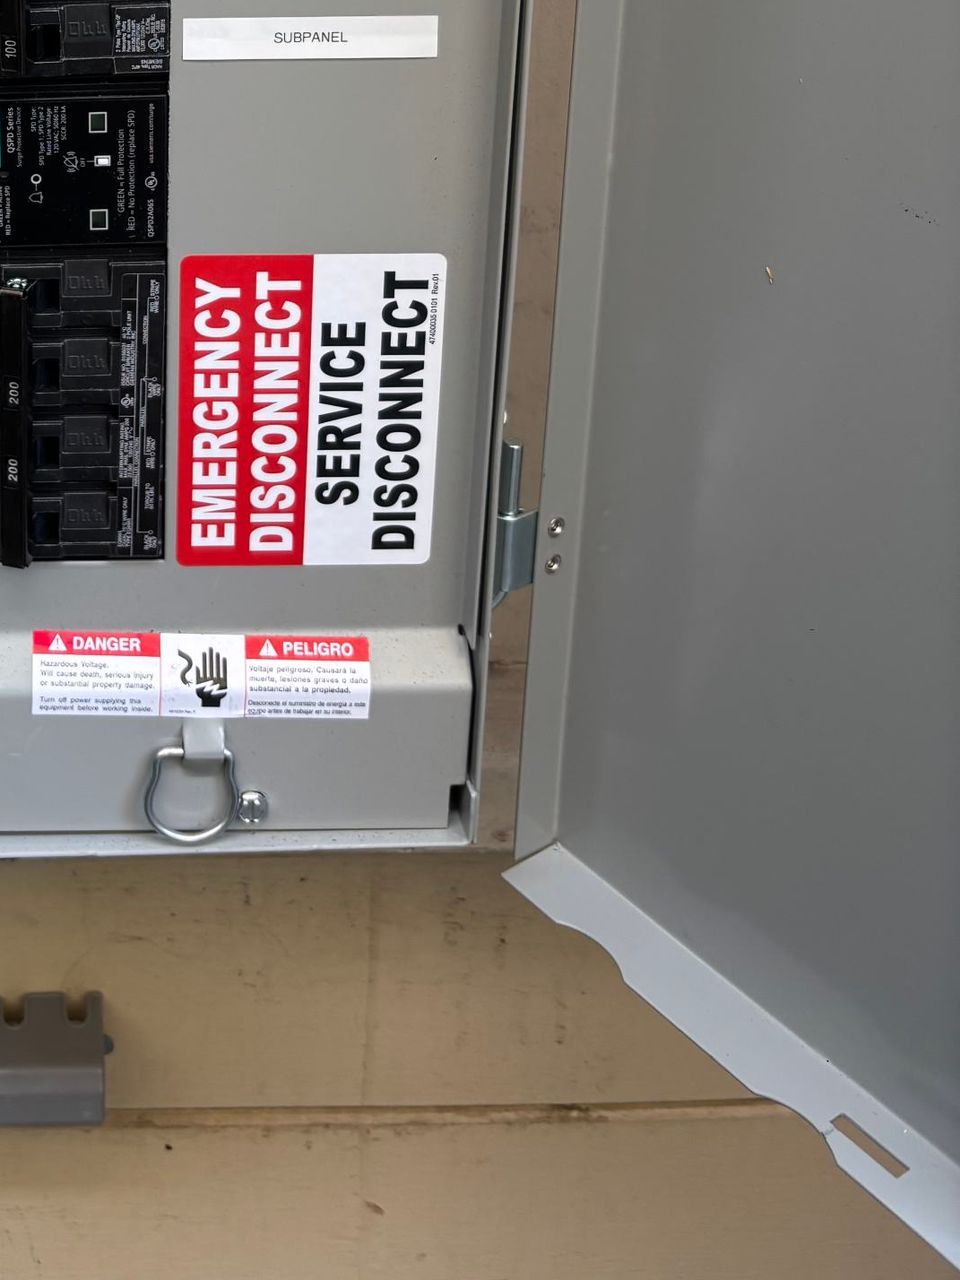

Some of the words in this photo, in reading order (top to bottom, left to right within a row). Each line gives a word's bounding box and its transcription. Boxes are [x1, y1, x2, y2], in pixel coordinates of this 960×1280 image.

[273, 31, 348, 43] SUBPANEL
[3, 39, 17, 59] 100
[6, 107, 14, 131] Series
[127, 110, 136, 127] SPD)
[6, 132, 15, 153] QSPD
[117, 129, 125, 165] Protection
[127, 129, 137, 158] (replace
[117, 188, 125, 213] GREEN
[128, 198, 135, 208] No
[128, 217, 136, 231] RED
[8, 382, 20, 404] 200
[191, 277, 241, 548] EMERGENCY
[249, 271, 302, 552] DISCONNECT
[315, 322, 366, 506] SERVICE
[371, 271, 429, 550] DISCONNECT
[7, 458, 18, 481] 200
[73, 637, 141, 652] DANGER
[283, 642, 353, 656] PELIGRO
[40, 660, 78, 668] Hazardous
[81, 661, 109, 669] Voltage.
